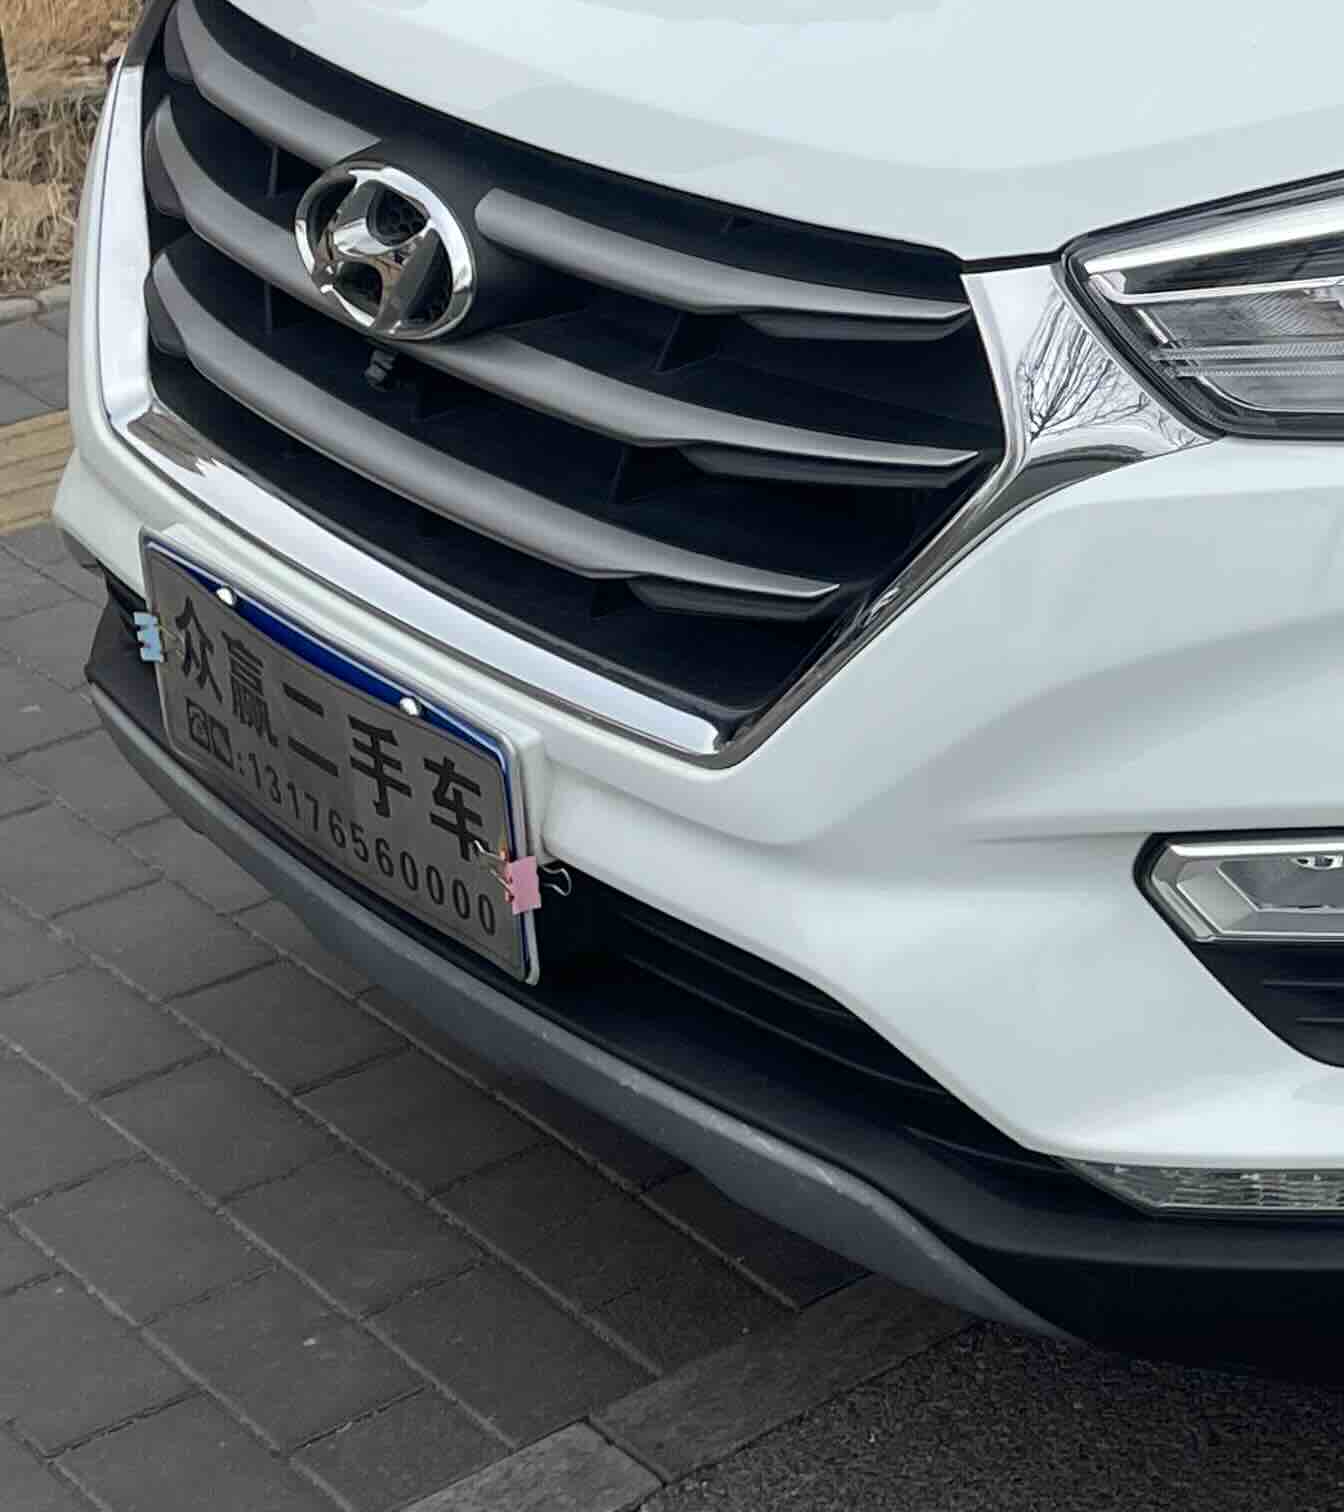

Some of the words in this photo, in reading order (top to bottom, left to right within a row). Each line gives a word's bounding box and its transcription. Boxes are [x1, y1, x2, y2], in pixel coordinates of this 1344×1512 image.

[176, 595, 491, 863] 众赢二手车
